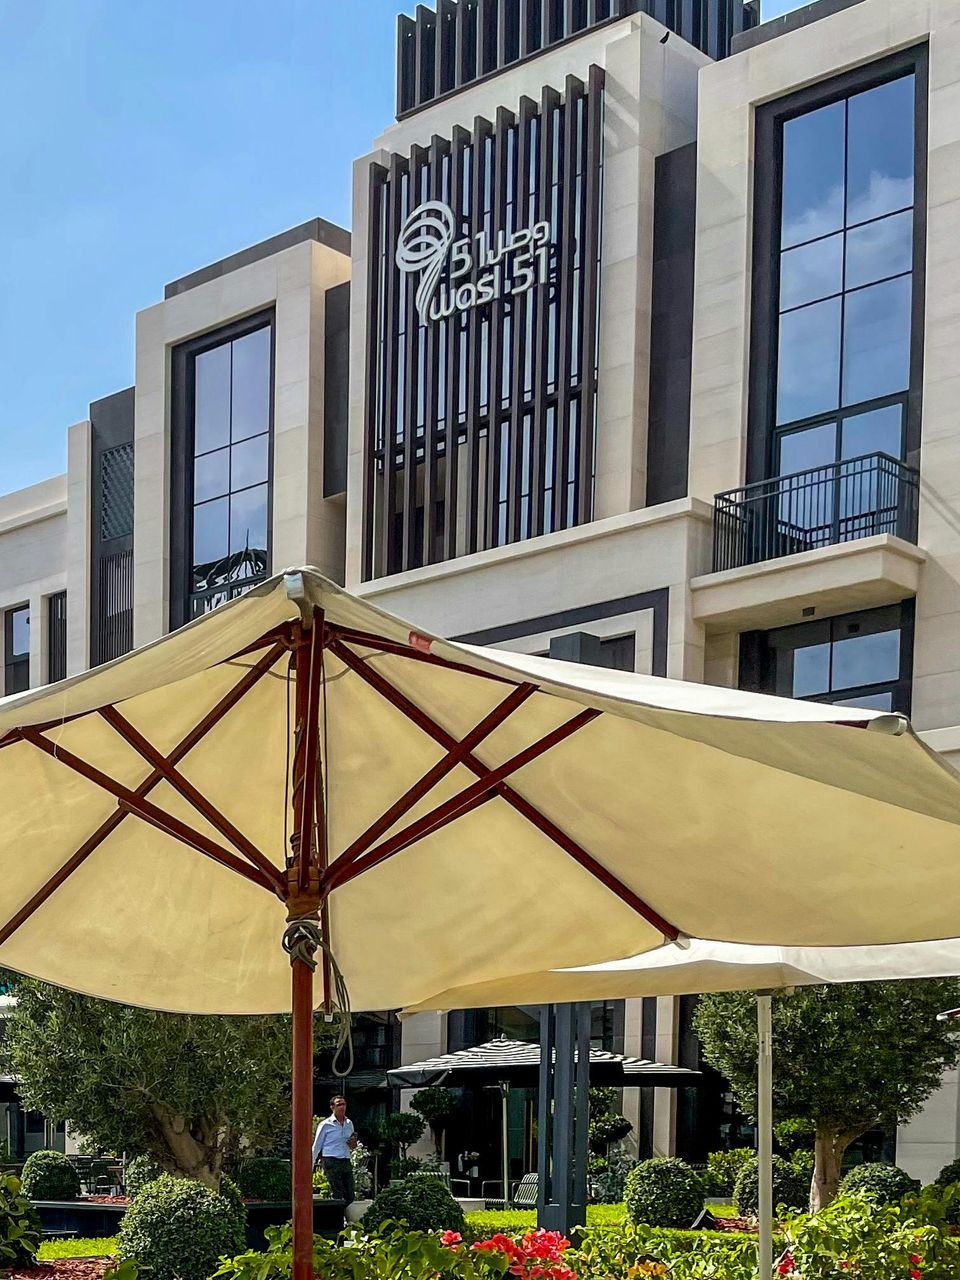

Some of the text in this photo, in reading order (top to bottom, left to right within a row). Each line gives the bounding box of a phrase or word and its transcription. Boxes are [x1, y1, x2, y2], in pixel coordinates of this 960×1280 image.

[487, 220, 550, 265] وصل
[430, 246, 548, 321] wasl 51
